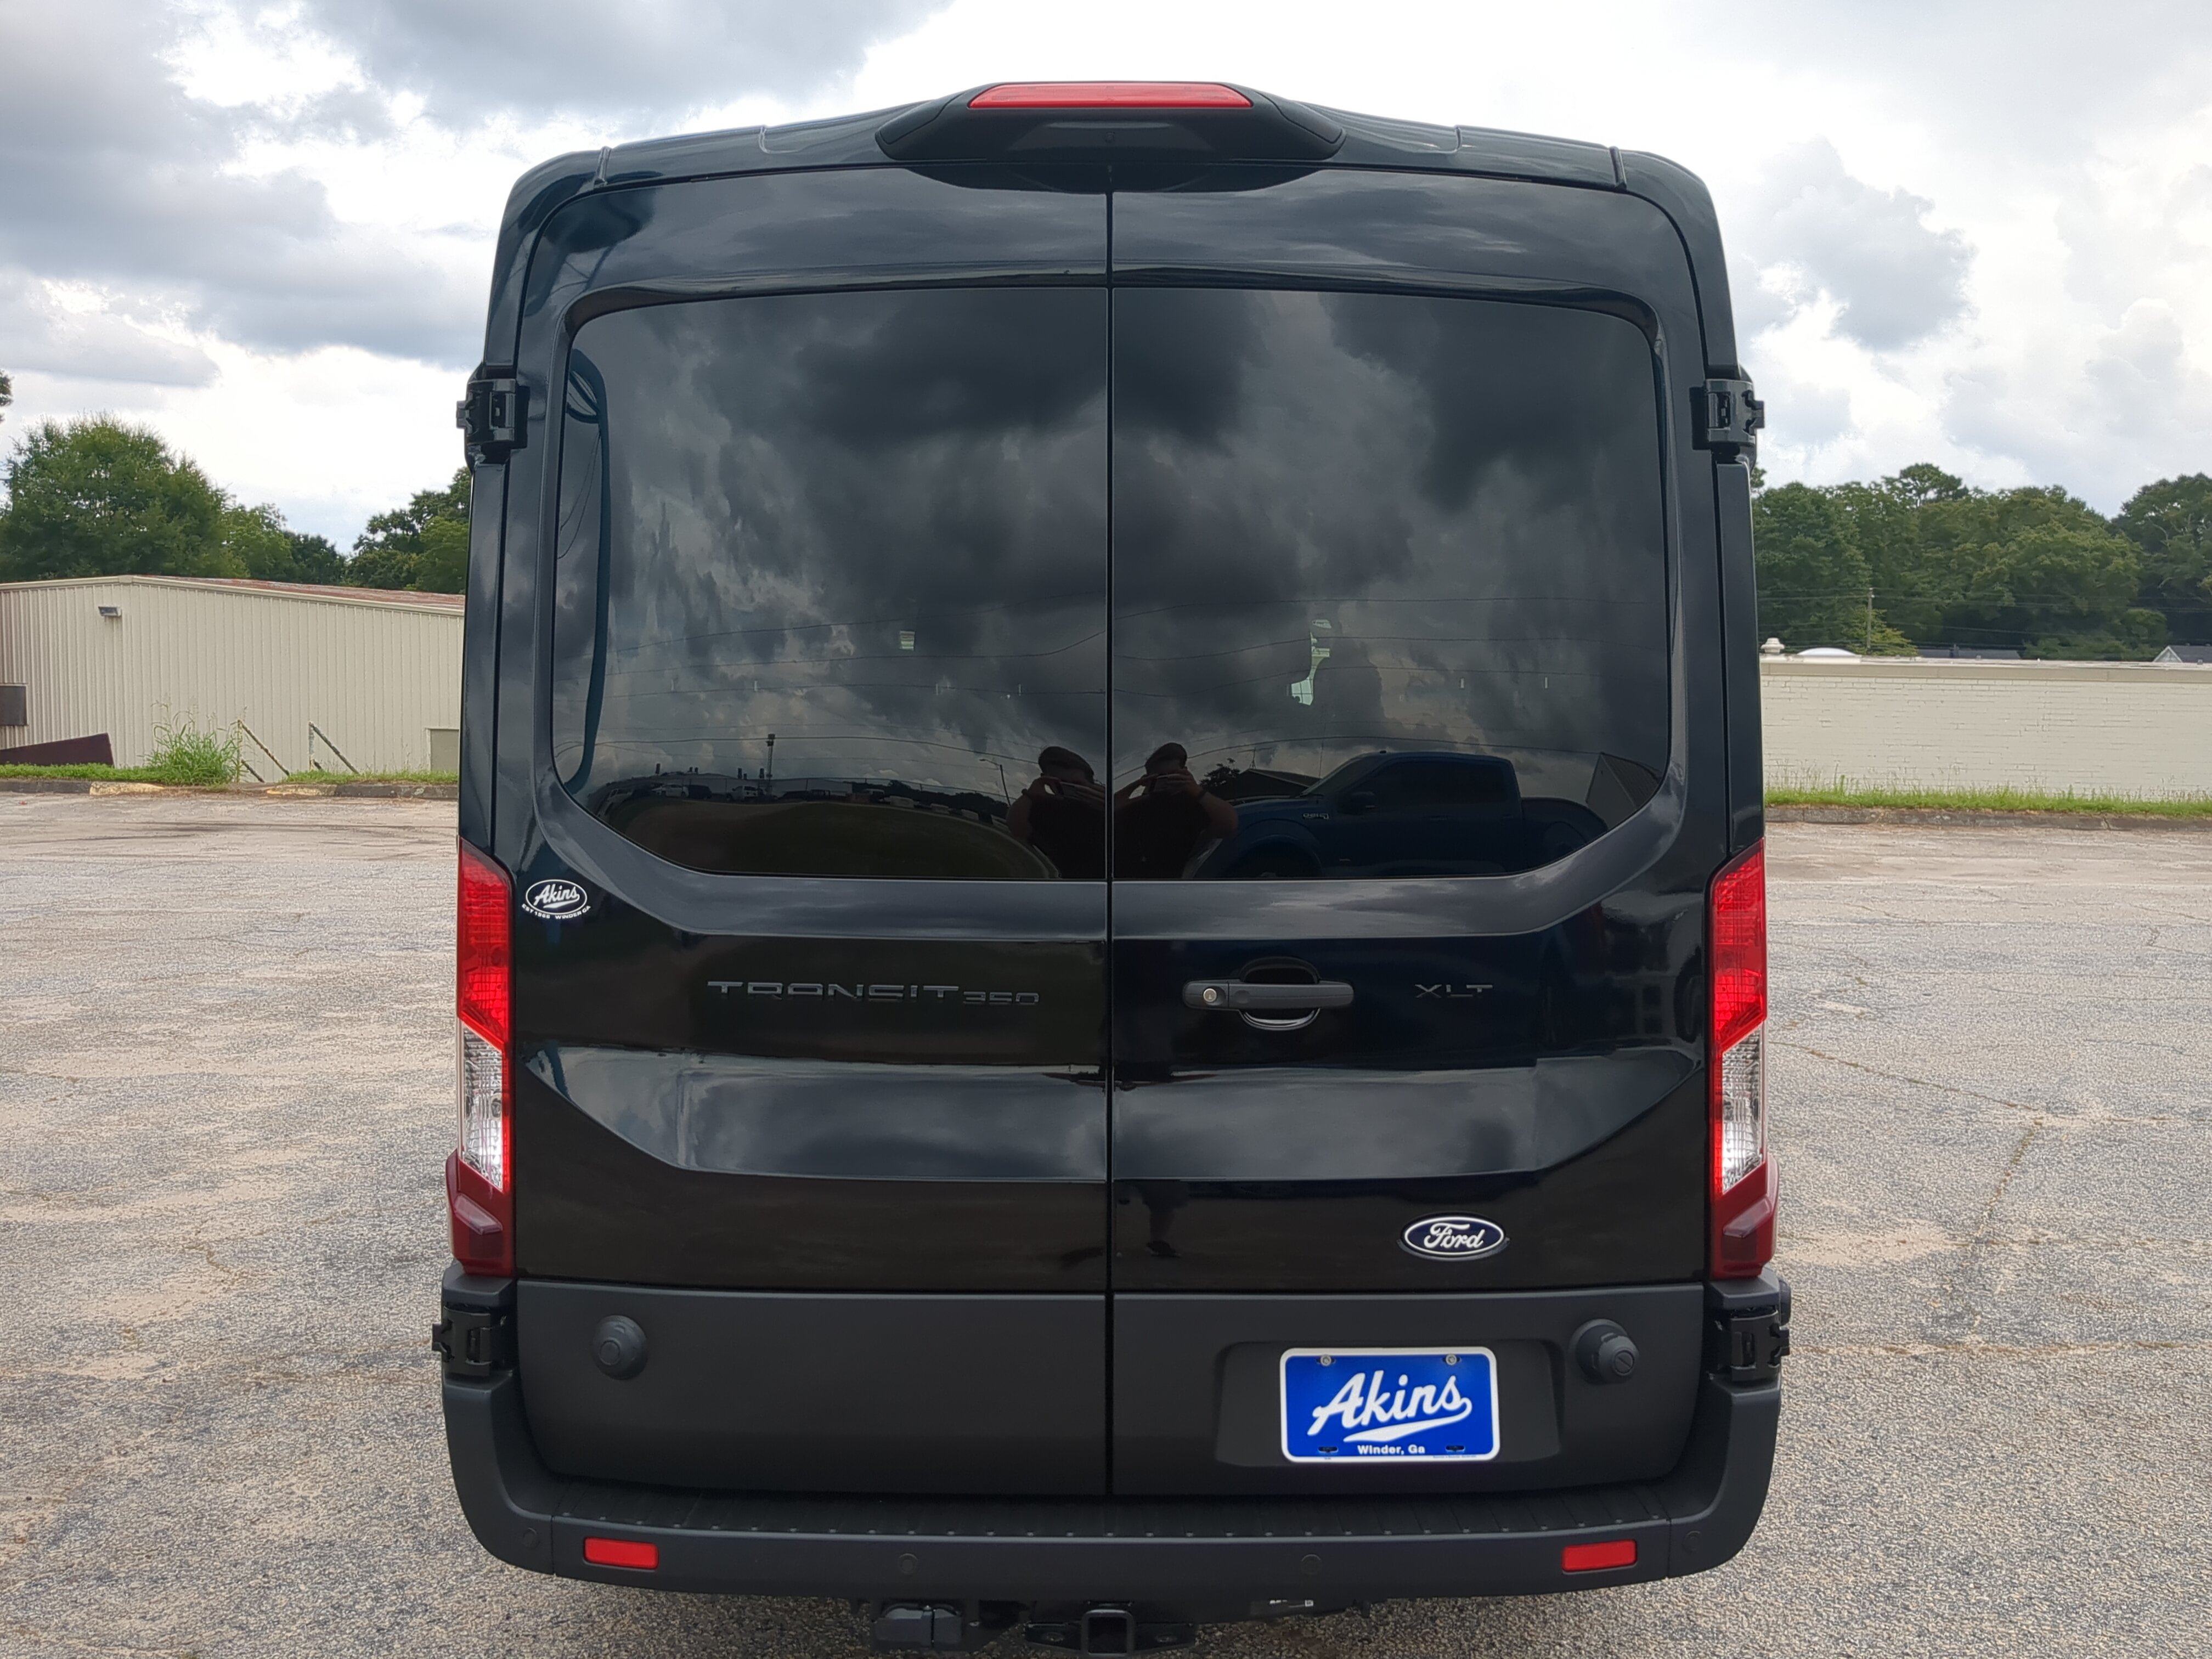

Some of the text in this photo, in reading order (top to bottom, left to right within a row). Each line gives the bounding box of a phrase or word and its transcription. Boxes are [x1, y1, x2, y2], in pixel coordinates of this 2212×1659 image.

[533, 884, 580, 908] Akins
[522, 903, 534, 913] EST
[555, 911, 582, 919] WINDER
[708, 981, 1039, 1005] TRANSIT 350
[1414, 984, 1493, 998] XLT
[1424, 1222, 1485, 1249] Ford
[1307, 1370, 1472, 1442] Akins
[1357, 1444, 1426, 1455] Winder, Ga
